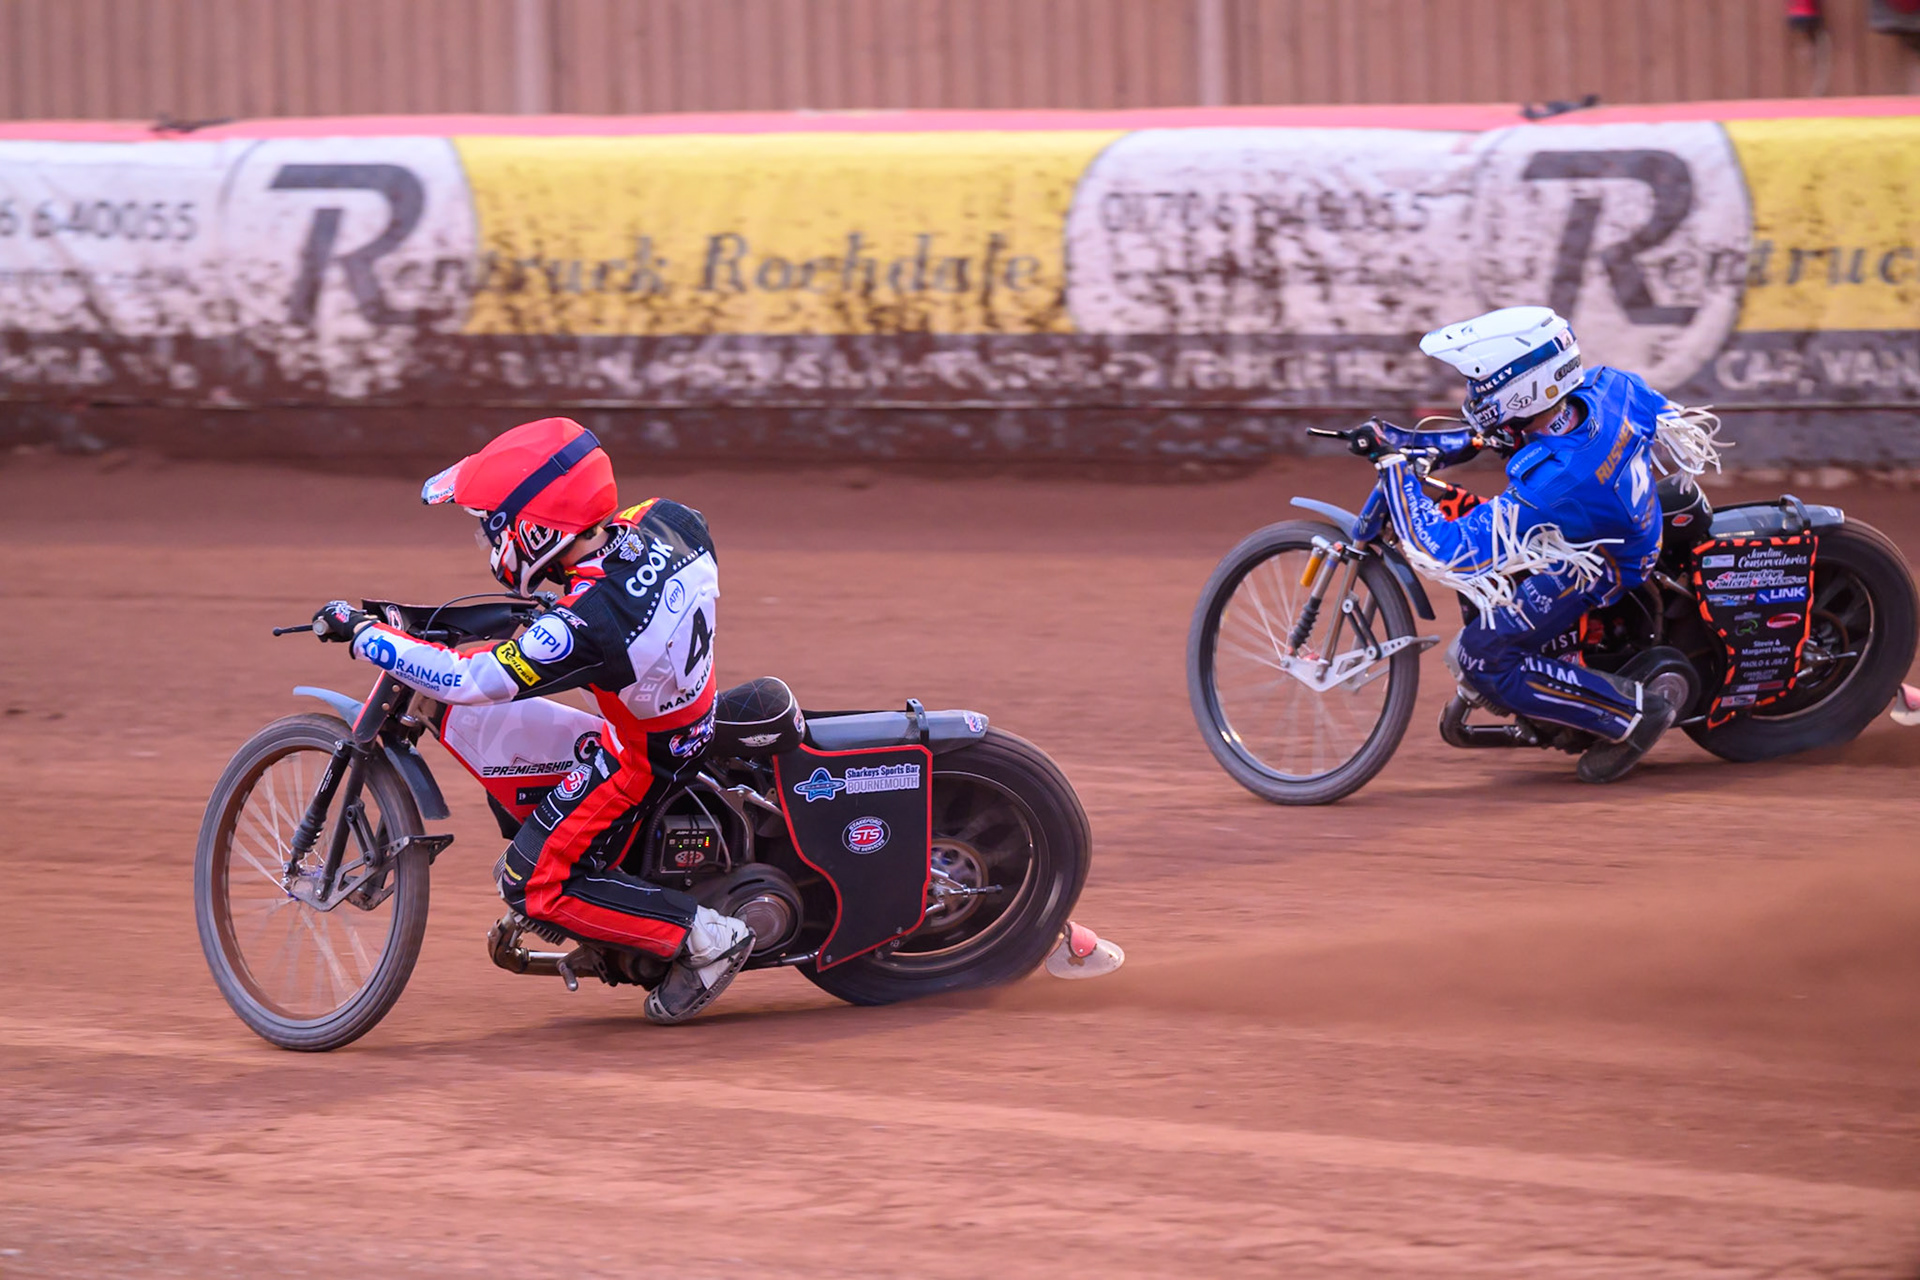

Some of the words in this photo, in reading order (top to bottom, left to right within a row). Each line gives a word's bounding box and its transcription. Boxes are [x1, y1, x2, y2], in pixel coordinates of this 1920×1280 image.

[625, 537, 675, 597] COOK
[668, 587, 682, 607] ATPI
[1770, 586, 1806, 599] LINK
[529, 623, 561, 653] ATPI
[684, 607, 713, 677] 4
[395, 671, 440, 692] RESOLUTIONS
[634, 654, 673, 702] BELL
[847, 768, 879, 779] Sharkeys
[881, 765, 904, 777] Sports
[905, 765, 919, 774] Bar
[847, 777, 919, 792] BOURNEMOUTH
[851, 828, 881, 841] STS
